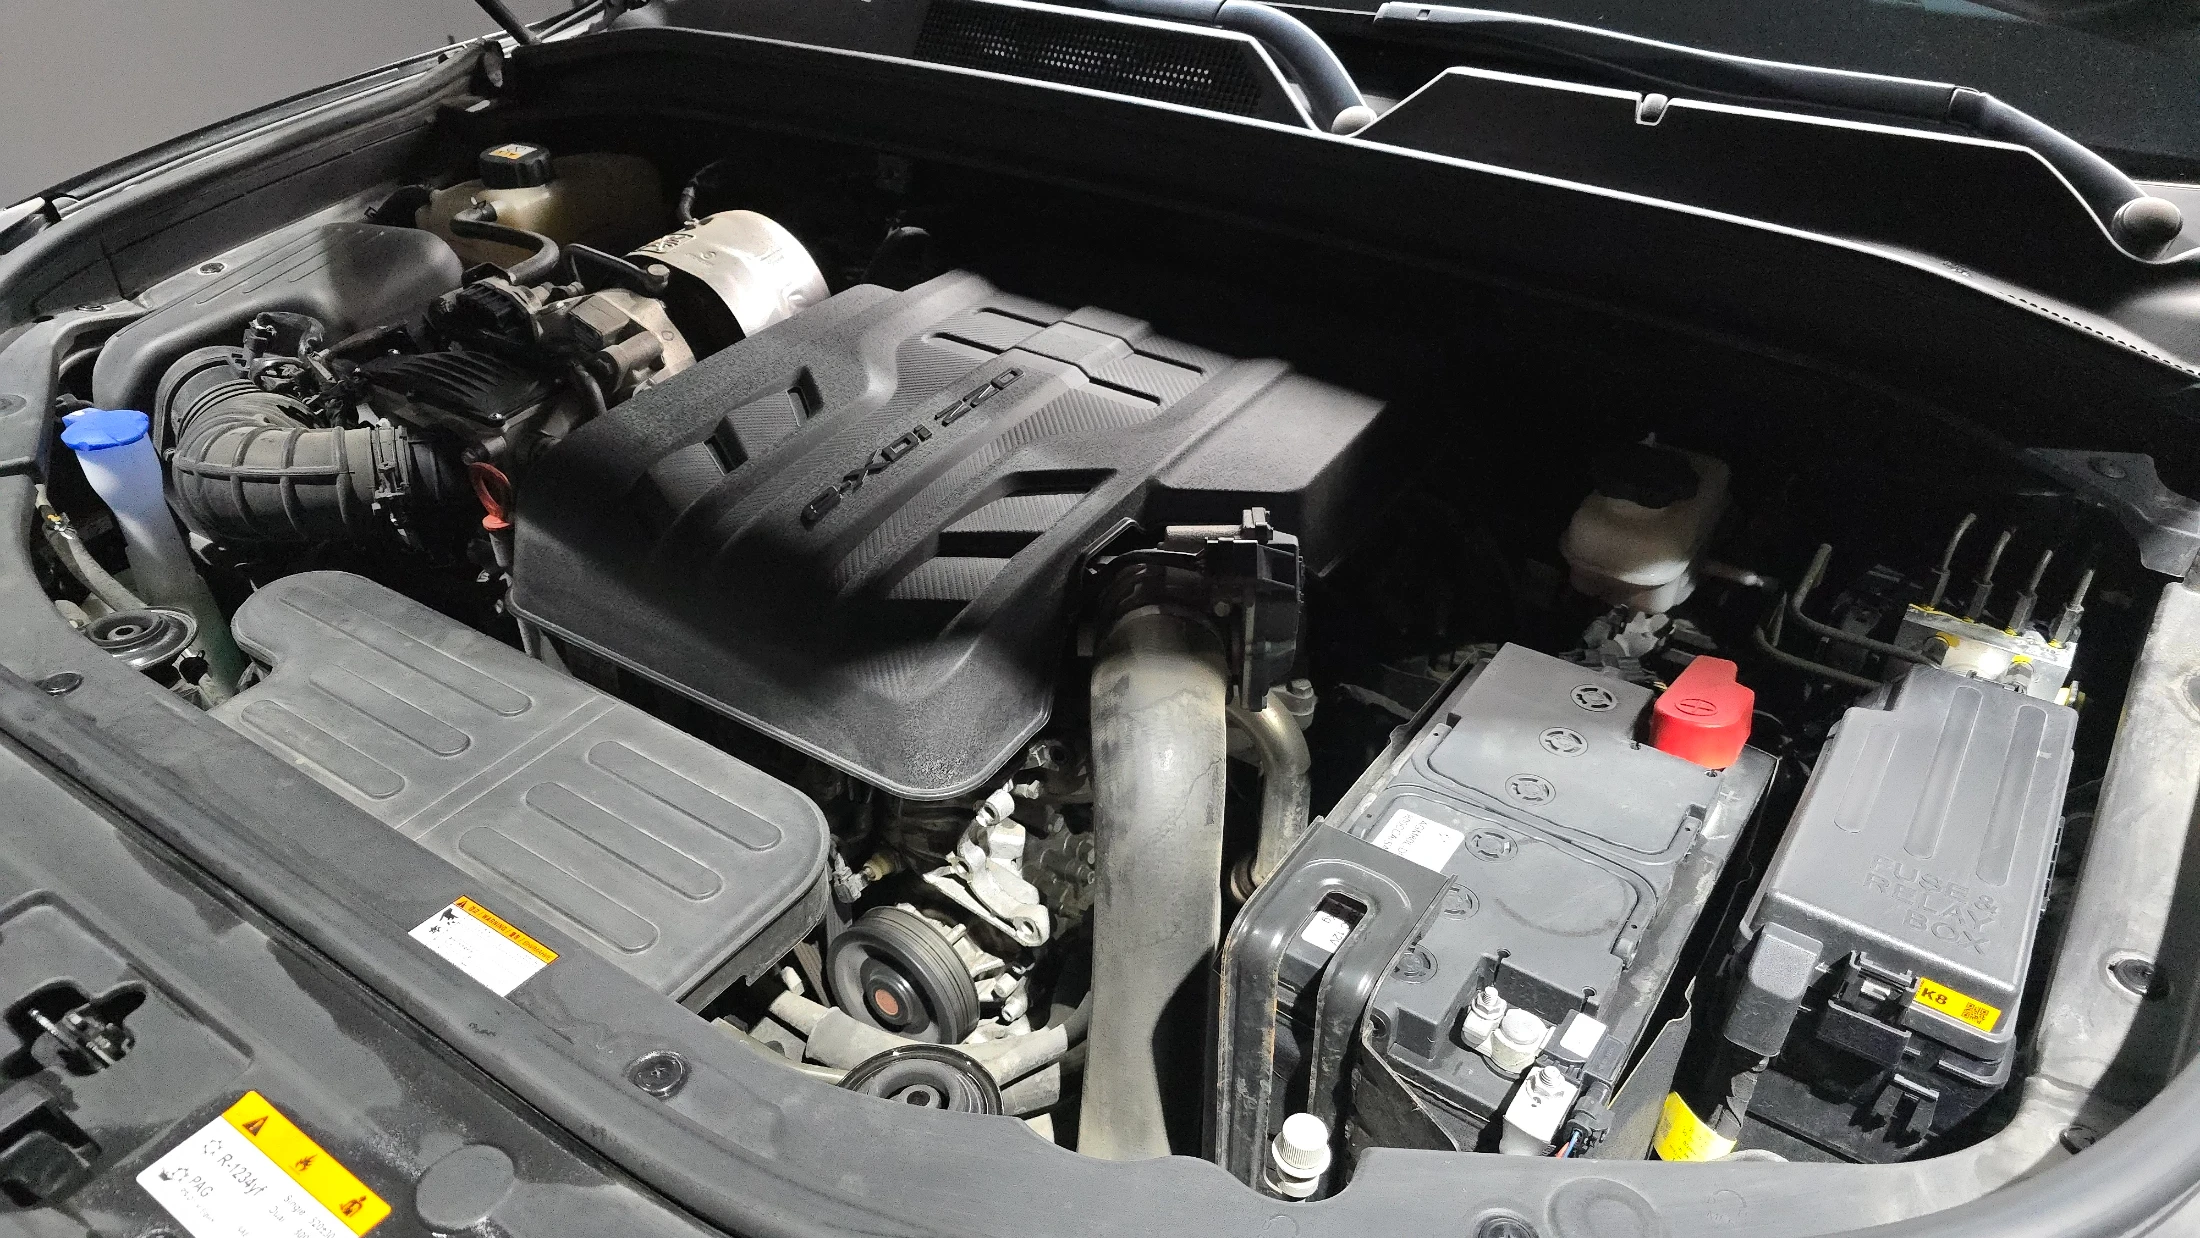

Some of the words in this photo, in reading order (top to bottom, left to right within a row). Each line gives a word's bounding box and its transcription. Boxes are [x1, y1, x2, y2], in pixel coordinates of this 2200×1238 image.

[934, 367, 1025, 427] 220
[1863, 871, 1995, 932] RELAY
[1870, 855, 1970, 899] FUSE
[1973, 894, 1998, 915] &
[481, 913, 508, 932] WARNING
[1902, 908, 1990, 955] BOX
[1921, 988, 1948, 1005] K8
[189, 1175, 214, 1198] PAG
[217, 1153, 268, 1196] R-1234yf
[283, 1194, 306, 1215] Single
